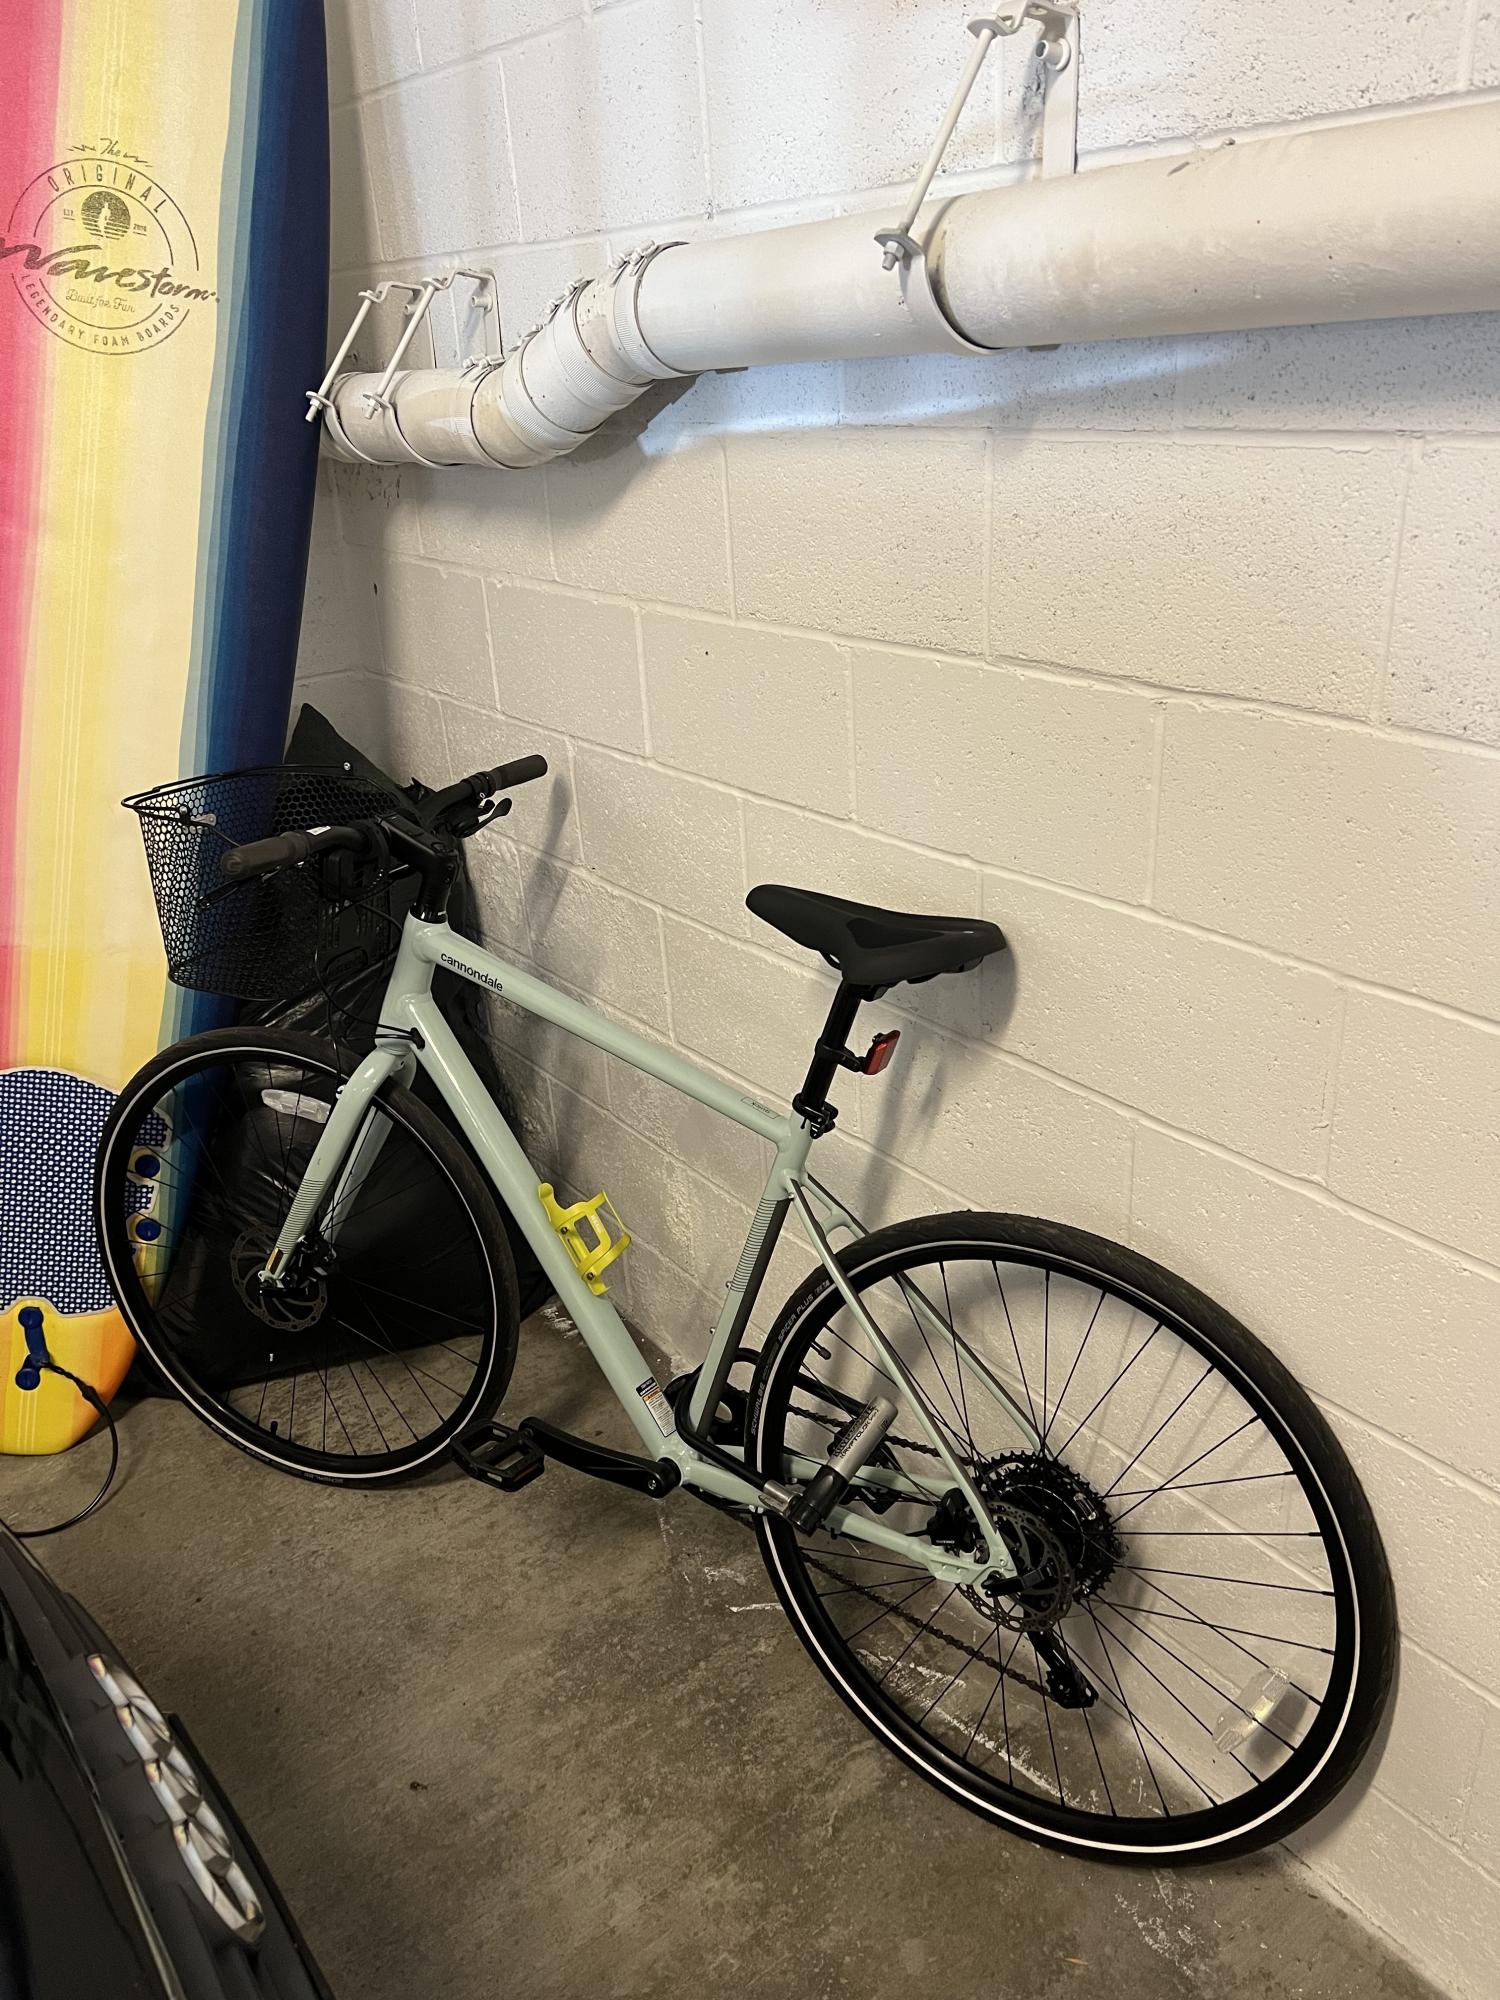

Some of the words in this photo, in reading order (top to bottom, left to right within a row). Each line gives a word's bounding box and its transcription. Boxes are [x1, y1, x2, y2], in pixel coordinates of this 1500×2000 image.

[100, 138, 121, 158] The
[47, 164, 167, 214] ORIGINAL
[21, 274, 85, 339] LEGENDARY
[93, 334, 130, 346] FOAM
[137, 304, 180, 342] BOARDS
[113, 297, 136, 313] Fun
[440, 953, 503, 992] cannondale
[777, 1314, 797, 1343] SPICER
[796, 1294, 814, 1315] PLUS
[750, 1382, 766, 1436] SCHWALBE
